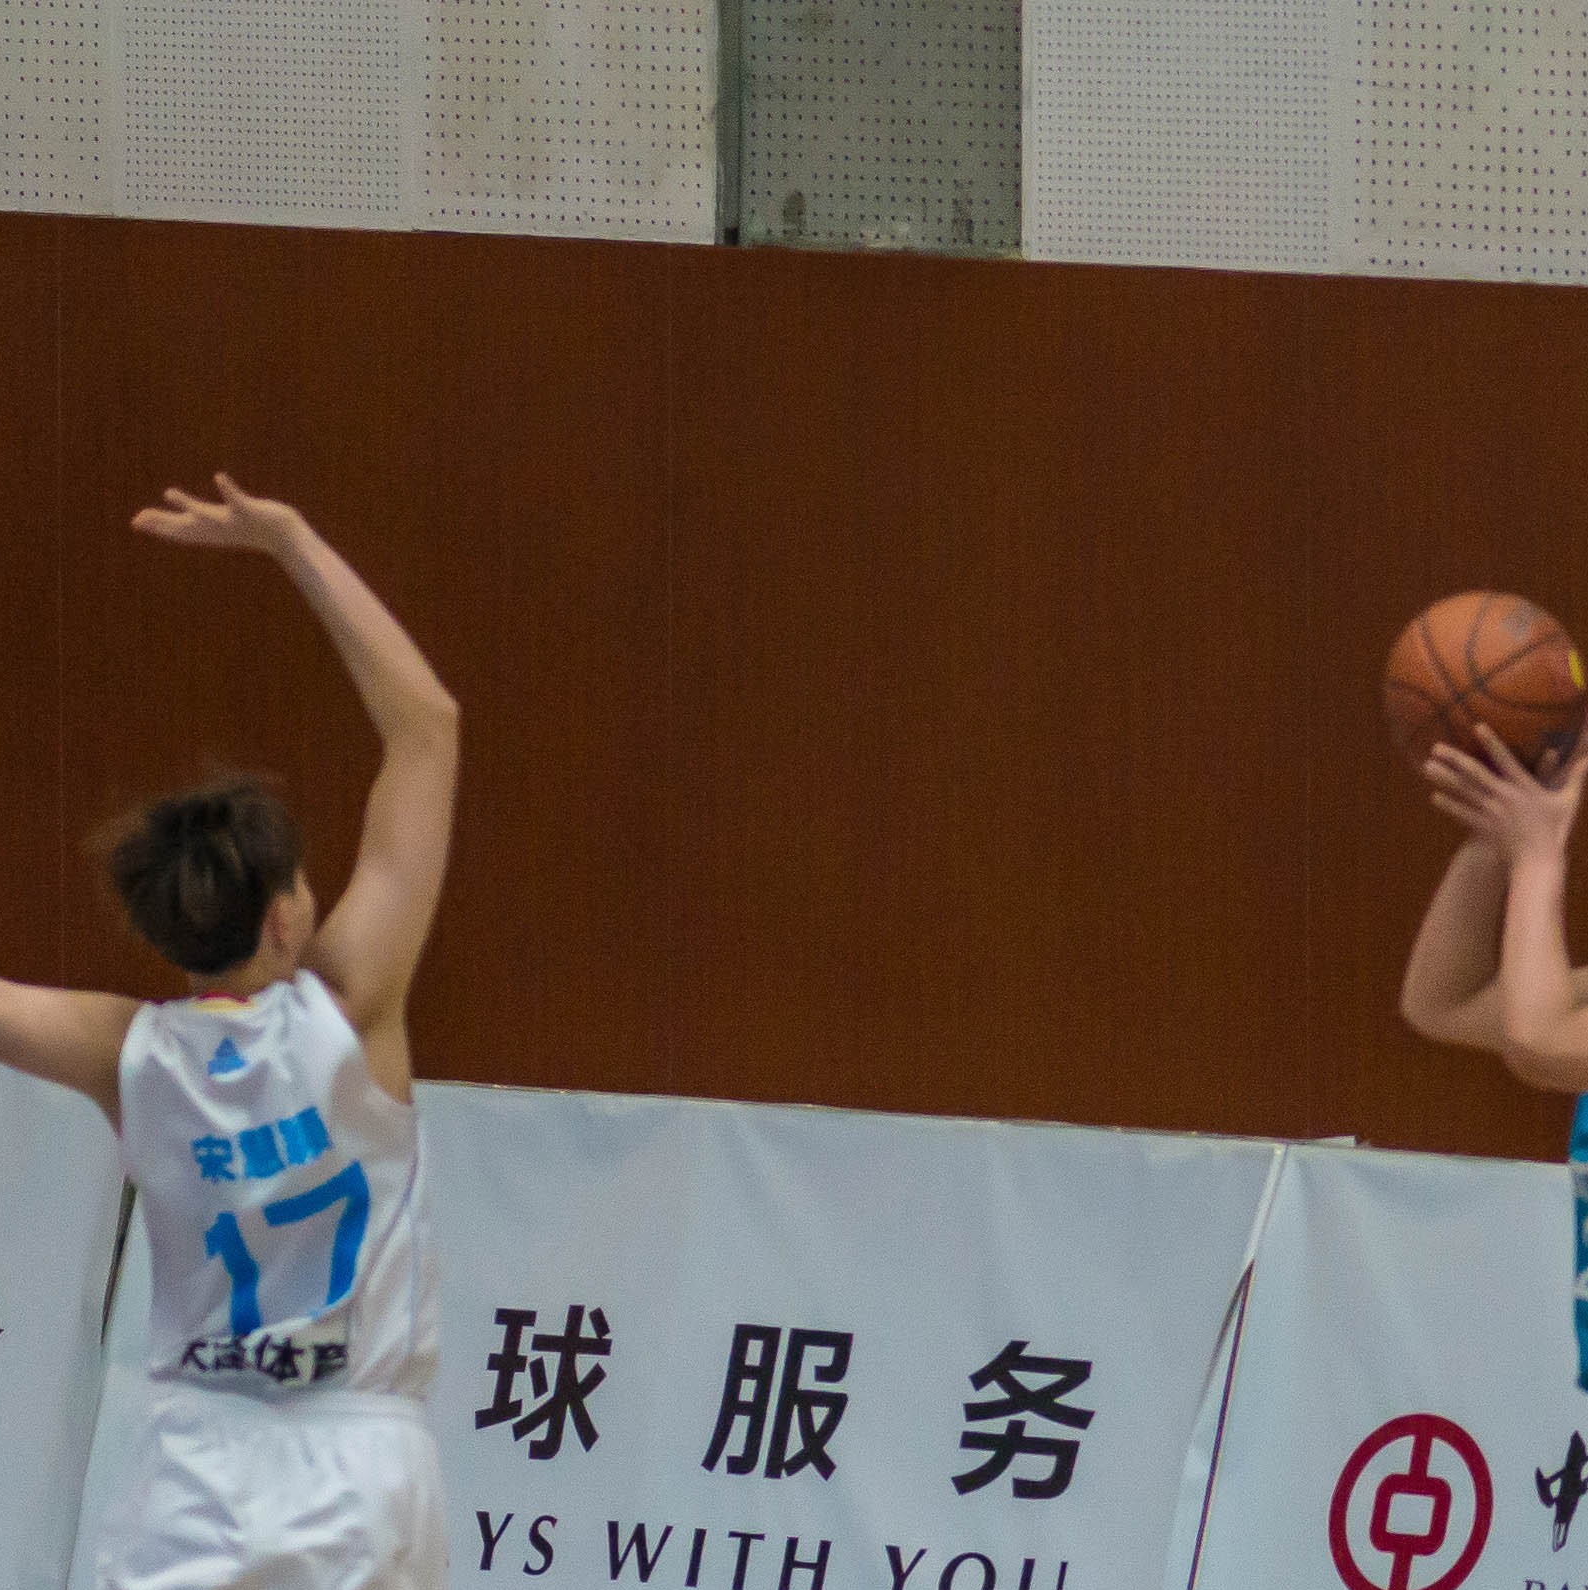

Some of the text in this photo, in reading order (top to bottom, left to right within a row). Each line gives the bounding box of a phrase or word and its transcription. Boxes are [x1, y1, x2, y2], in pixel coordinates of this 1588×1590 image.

[205, 1160, 370, 1336] 17
[475, 1304, 1094, 1499] 球服务
